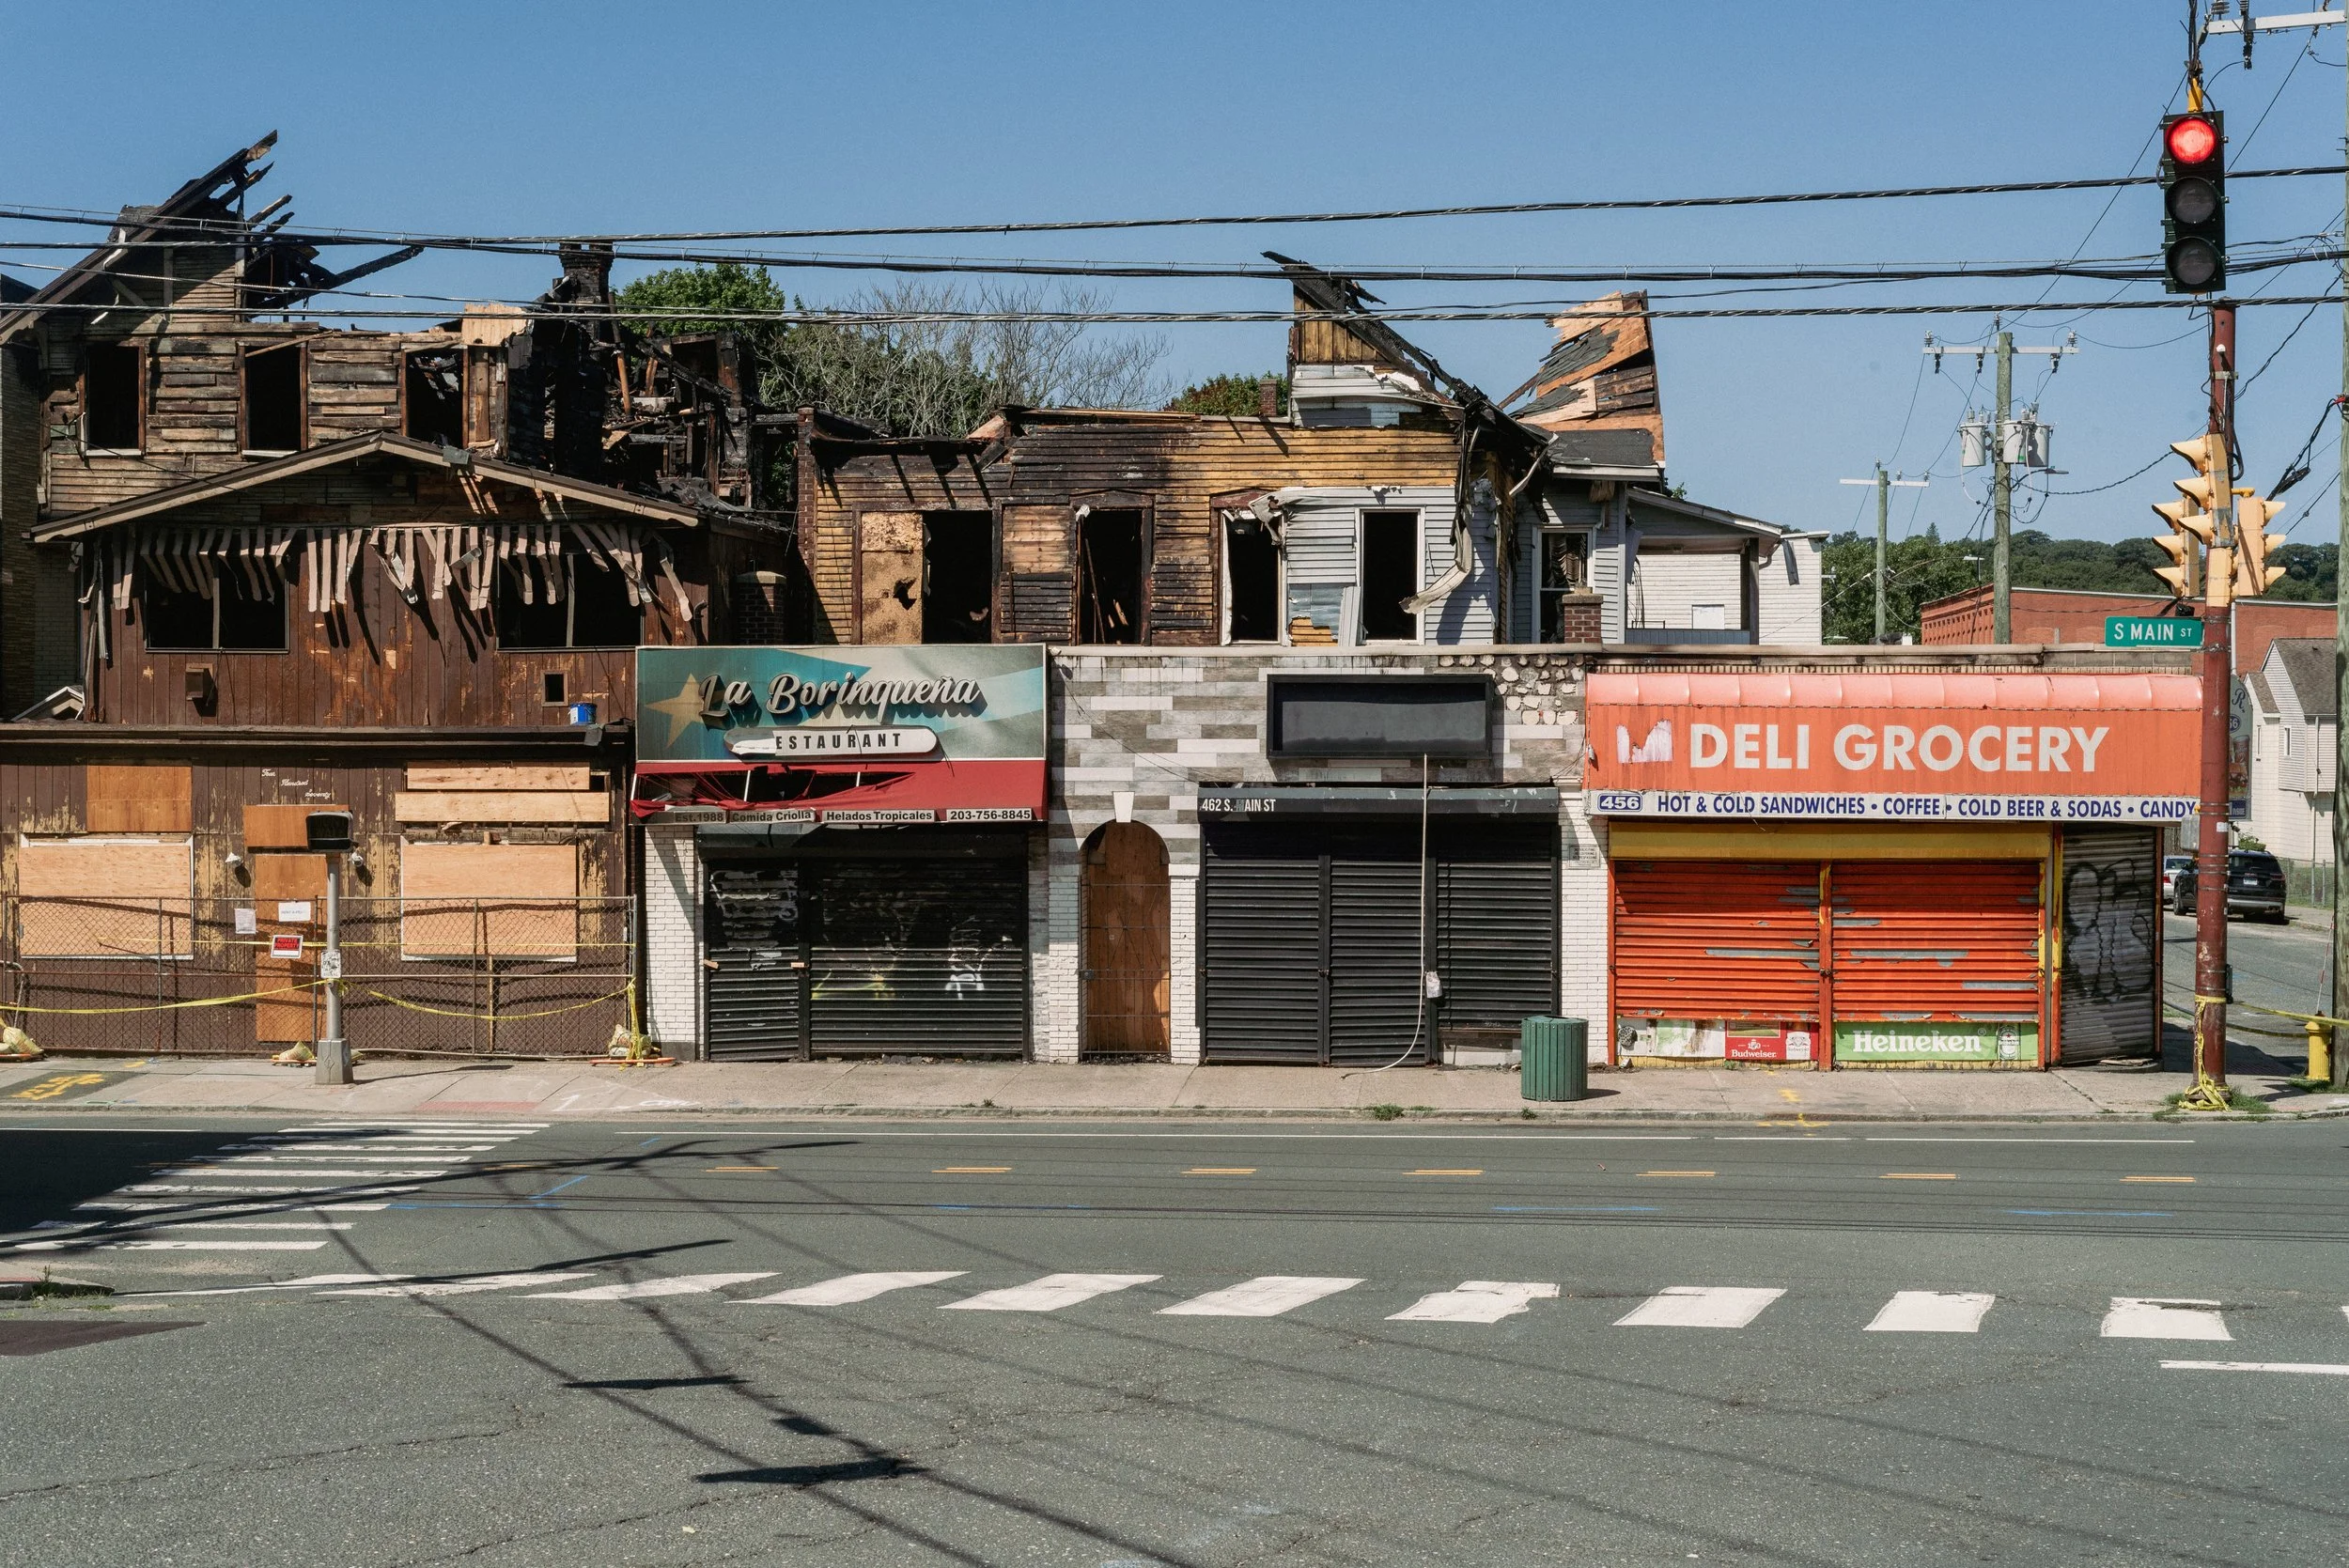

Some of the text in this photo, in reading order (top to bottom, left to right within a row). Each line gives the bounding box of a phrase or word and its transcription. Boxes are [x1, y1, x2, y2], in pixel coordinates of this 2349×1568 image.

[2113, 623, 2192, 641] S MAIN ST
[699, 671, 982, 724] La Borinqueña
[775, 733, 901, 751] ESTAURANT
[1690, 723, 2110, 772] DELI GROCERY
[280, 778, 309, 786] Hundred
[304, 789, 331, 800] Seventy
[1202, 799, 1221, 812] 462
[1223, 799, 1233, 812] S.
[1263, 799, 1276, 812] ST
[1599, 797, 1641, 811] 456
[1657, 796, 2196, 818] HOT & COLD SANDWICHES COFFEE COLD BEER & SODAS CANDY
[675, 811, 812, 822] Est.1988 Comida Criolla
[826, 811, 932, 823] Helados Tropicales
[950, 810, 1031, 820] 203-756-8845
[1852, 1030, 1982, 1052] Heineken
[1731, 1049, 1777, 1058] Budweiser
